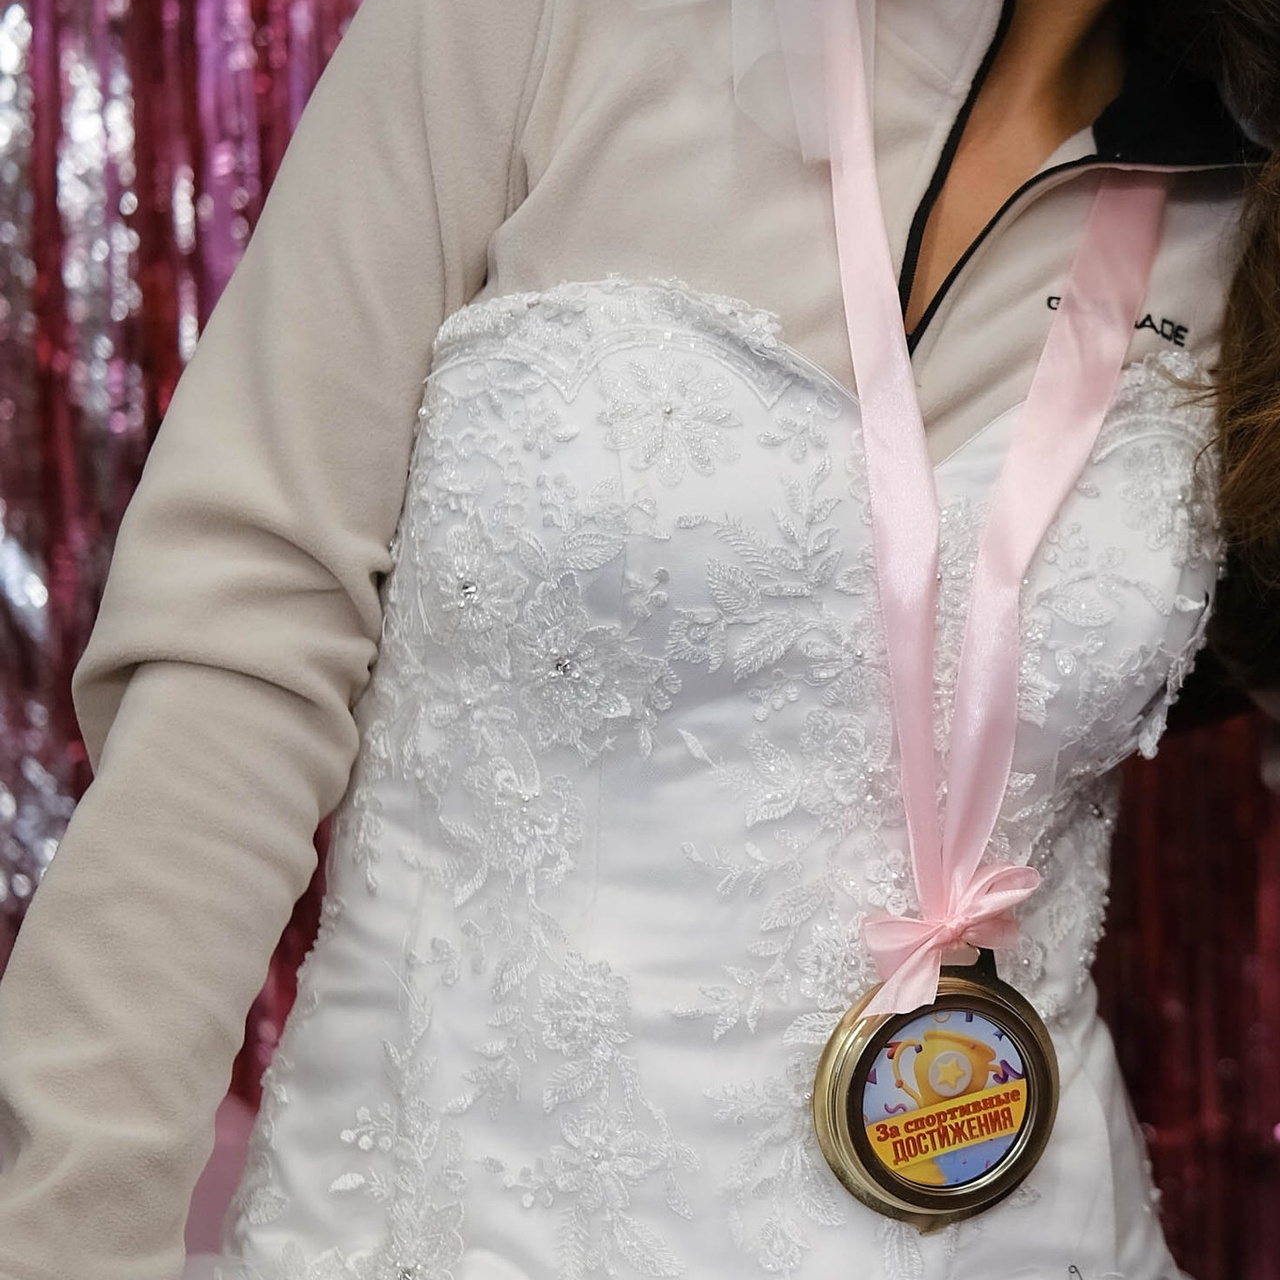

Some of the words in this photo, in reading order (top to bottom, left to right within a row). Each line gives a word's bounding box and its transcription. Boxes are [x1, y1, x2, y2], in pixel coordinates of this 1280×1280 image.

[875, 1123, 900, 1143] За
[904, 1089, 1020, 1134] спортивные
[892, 1106, 1014, 1166] ДОСТИЖЕНИЯ
